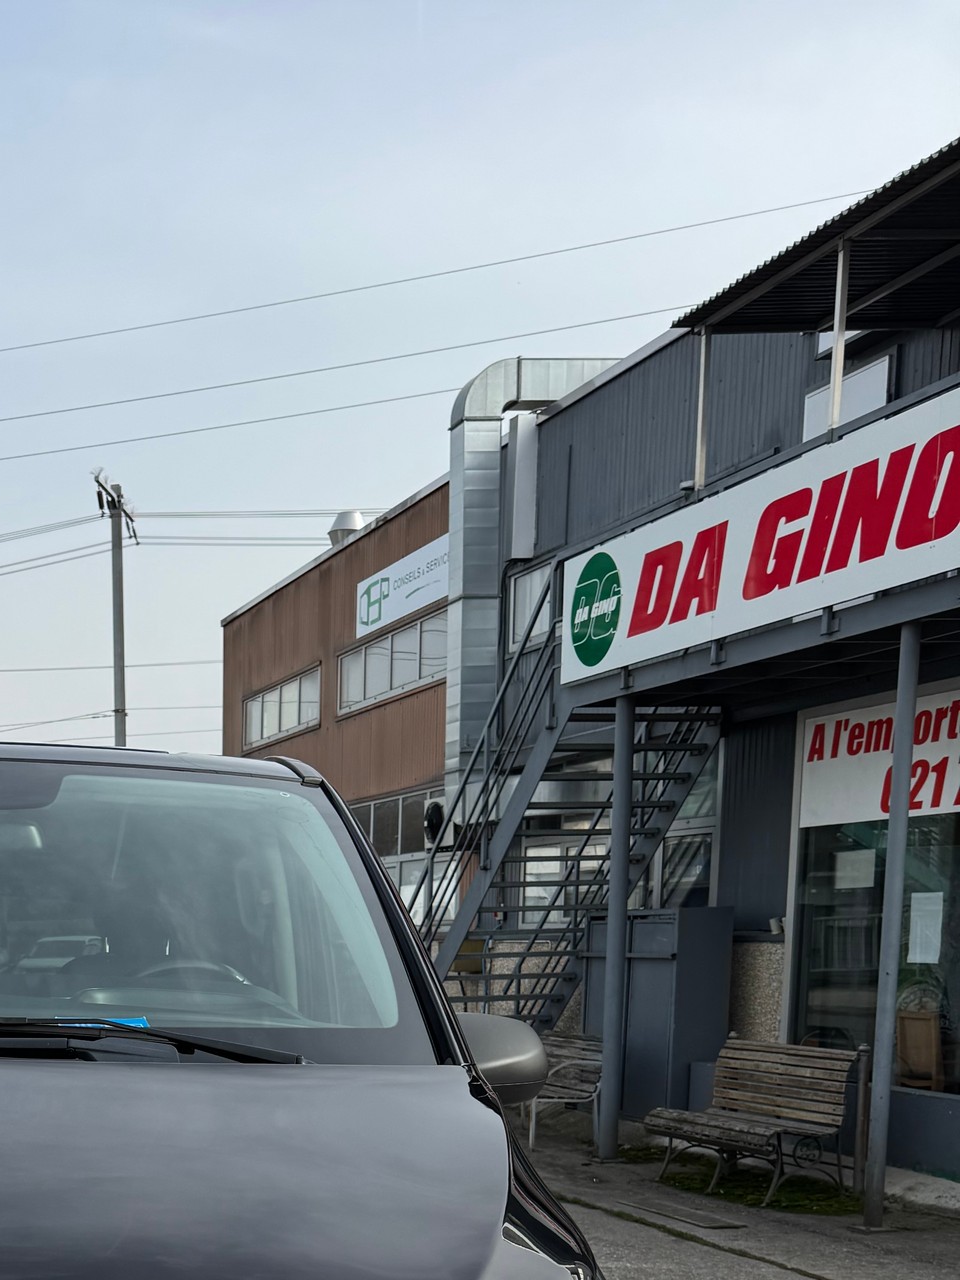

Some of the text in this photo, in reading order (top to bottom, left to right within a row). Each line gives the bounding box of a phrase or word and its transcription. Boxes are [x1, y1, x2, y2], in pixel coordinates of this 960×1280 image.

[627, 425, 960, 638] DA GINO
[392, 567, 421, 591] CONSEILS
[426, 551, 449, 573] SERVIC
[574, 595, 618, 624] DA GINO
[807, 698, 960, 763] A l'emort
